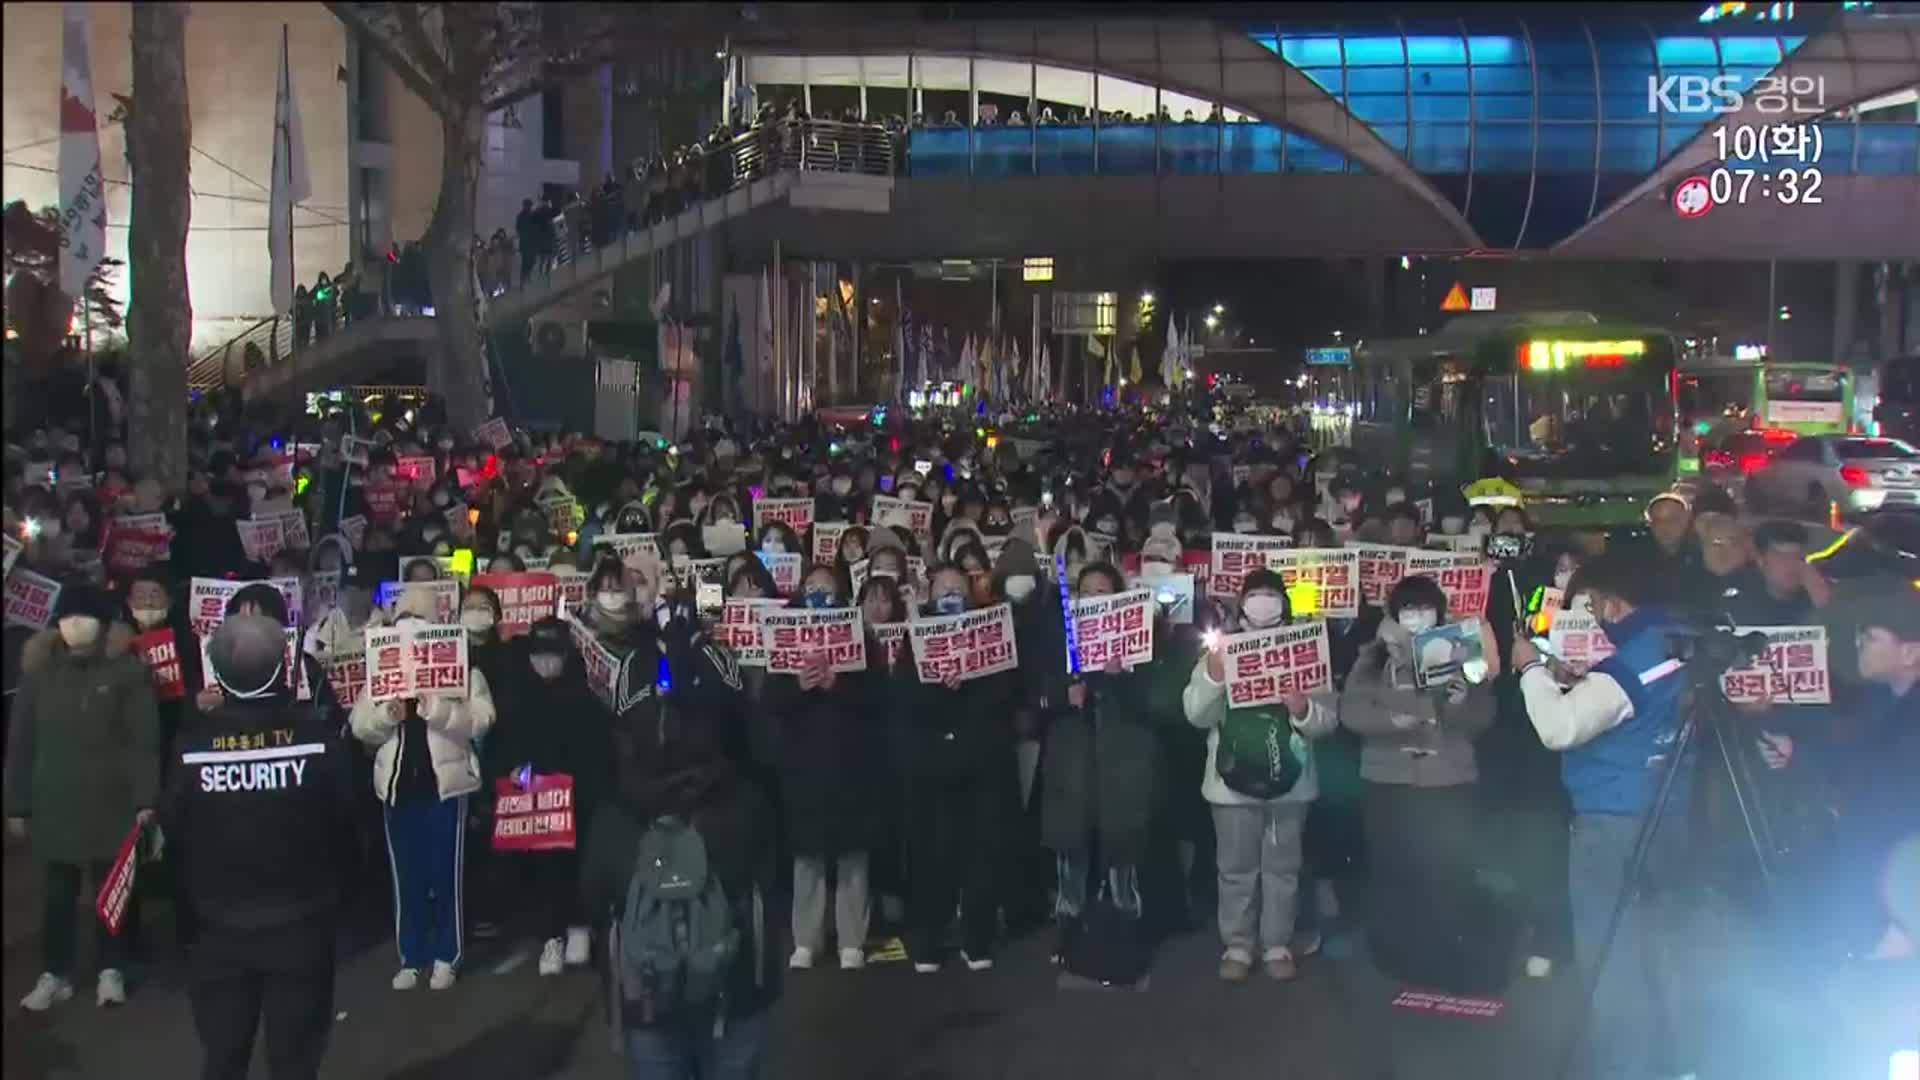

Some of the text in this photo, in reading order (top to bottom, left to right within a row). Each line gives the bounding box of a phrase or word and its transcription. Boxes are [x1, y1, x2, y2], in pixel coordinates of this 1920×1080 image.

[924, 622, 1003, 658] 윤석열
[1078, 606, 1143, 641] 윤석열
[965, 640, 1012, 673] 퇴진!
[1111, 629, 1149, 657] 퇴진!
[1237, 640, 1318, 677] 윤석열
[1231, 664, 1327, 703] 정권 퇴진!
[1726, 671, 1825, 696] 정권 퇴진!
[272, 729, 294, 745] TV
[200, 758, 306, 792] SECURITY
